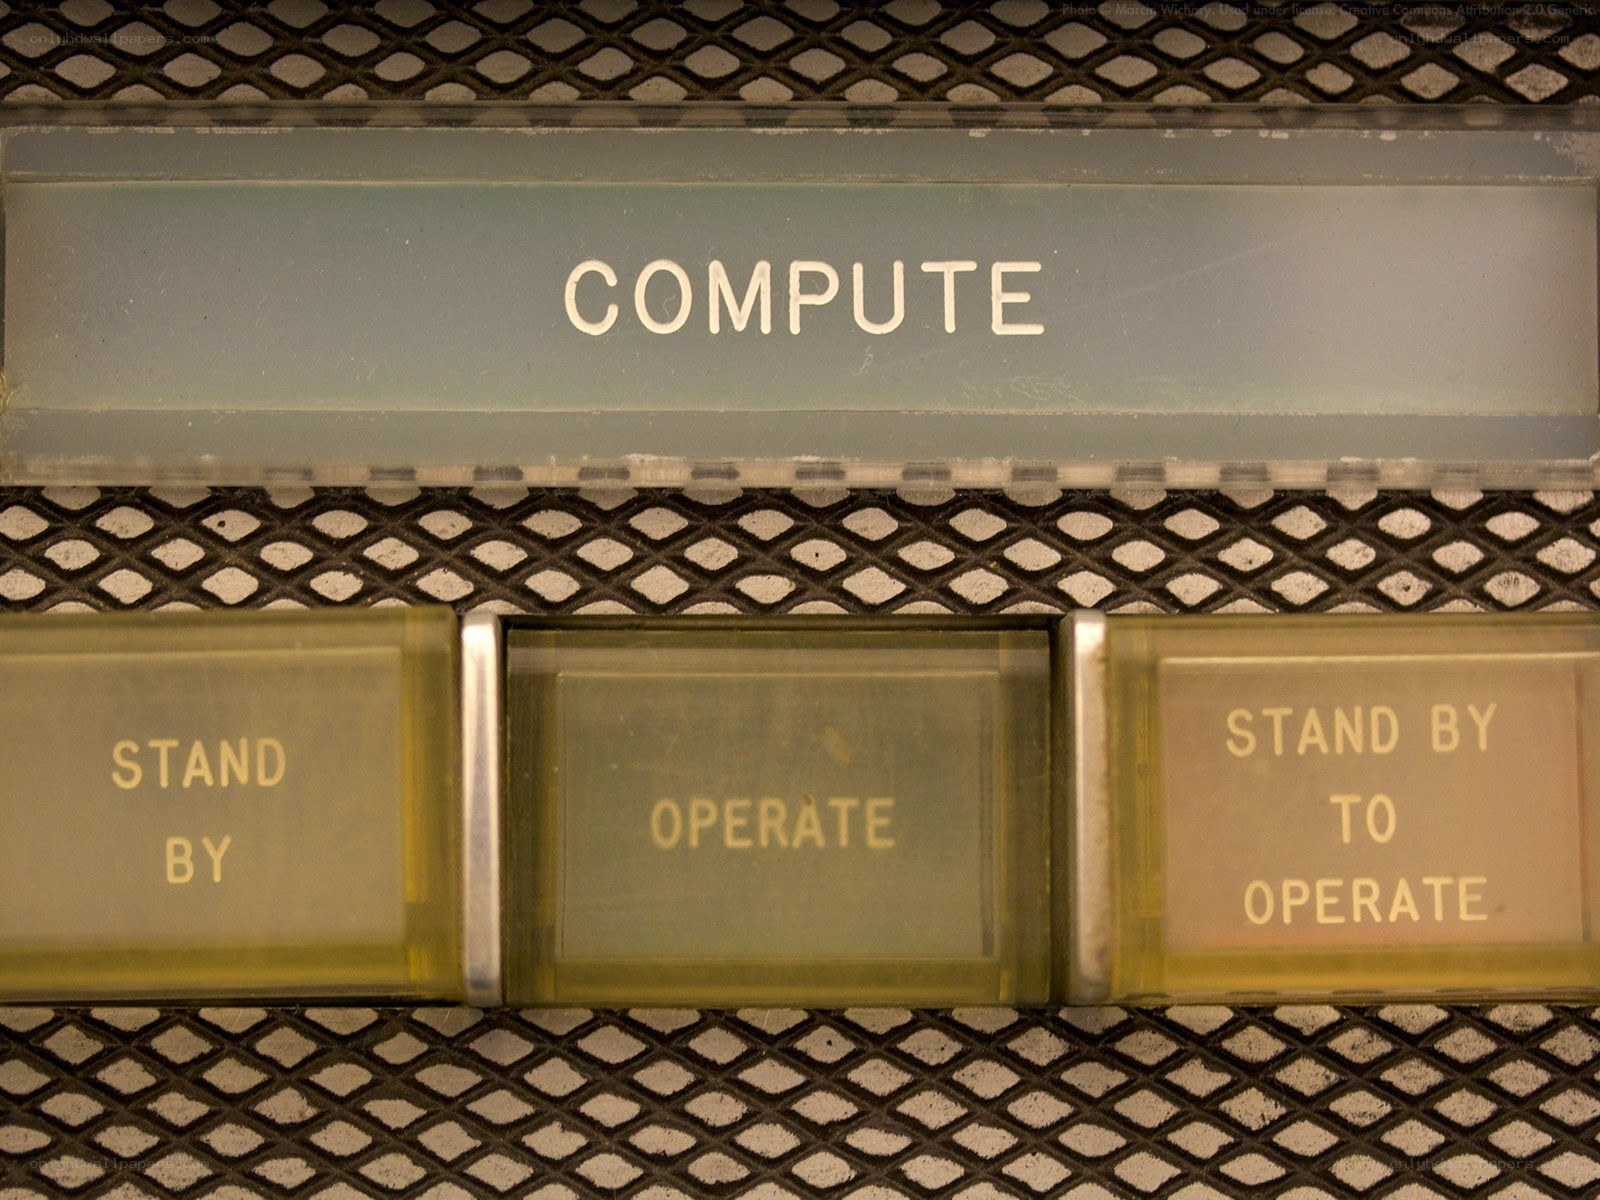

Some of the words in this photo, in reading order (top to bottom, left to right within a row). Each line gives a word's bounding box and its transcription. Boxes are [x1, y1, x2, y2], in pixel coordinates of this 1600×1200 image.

[564, 260, 1045, 335] COMPUTE
[1226, 704, 1399, 757] STAND
[1431, 702, 1497, 753] BY
[112, 737, 286, 789] STAND
[651, 796, 896, 849] OPERATE
[1329, 793, 1397, 844] TO
[166, 834, 232, 884] BY
[1244, 876, 1488, 925] OPERATE
